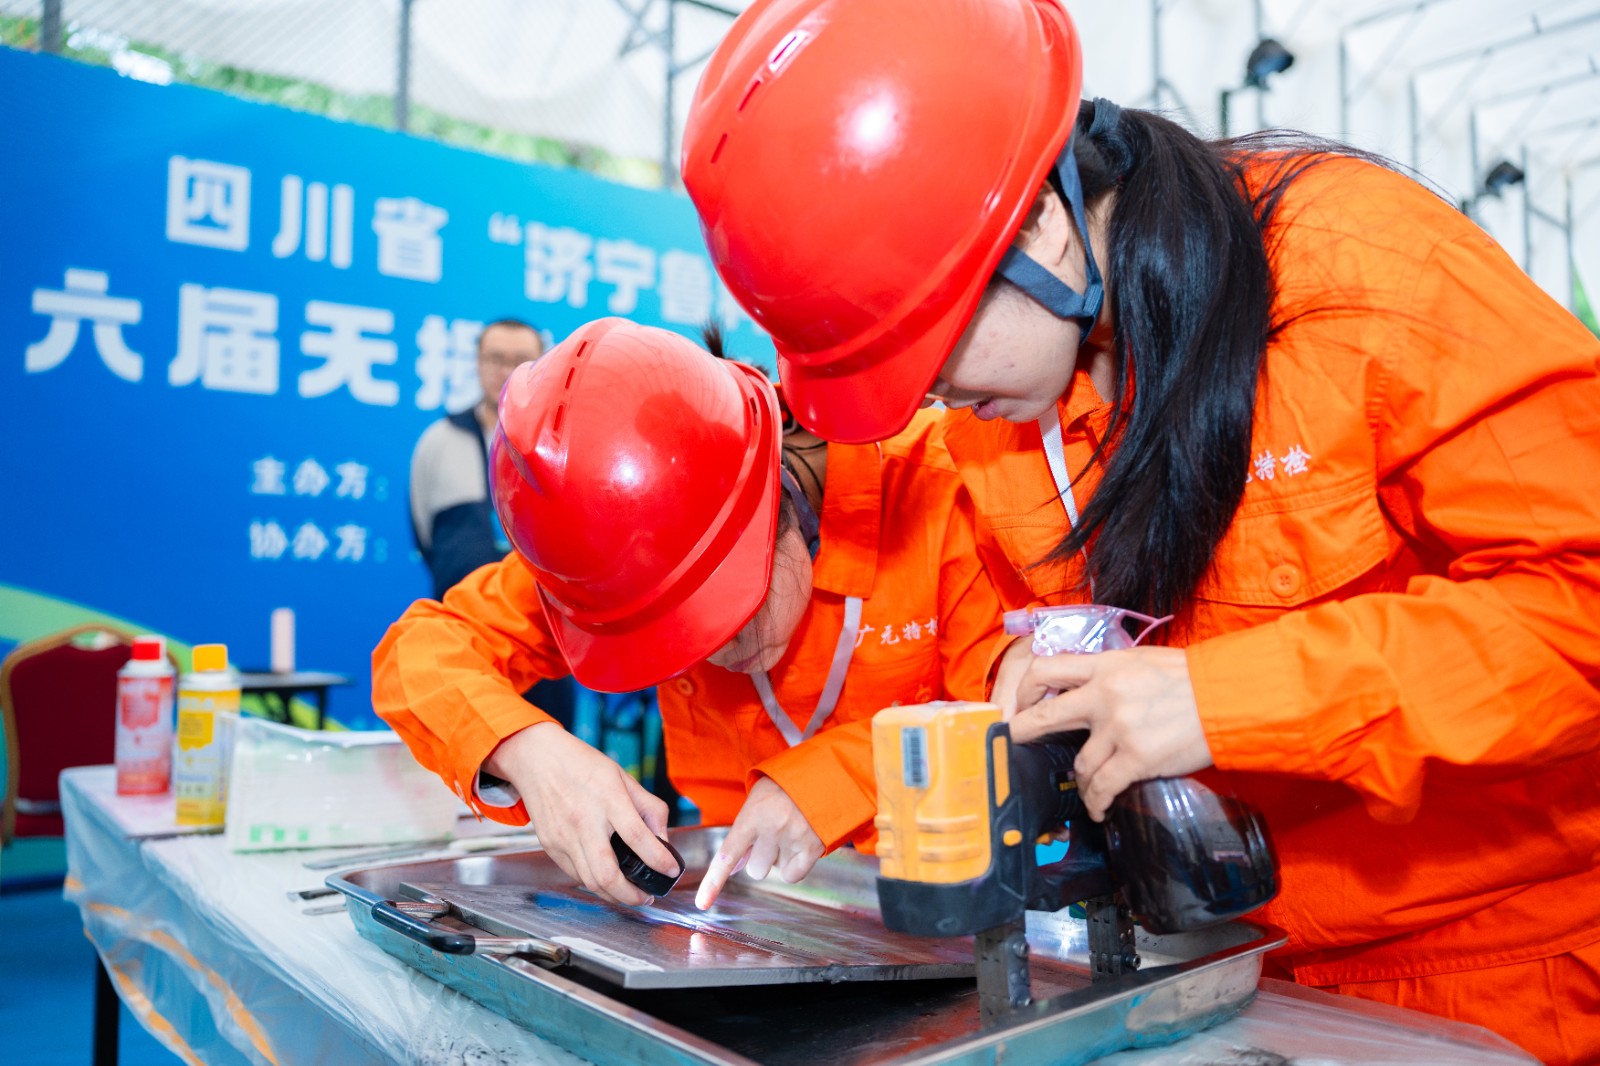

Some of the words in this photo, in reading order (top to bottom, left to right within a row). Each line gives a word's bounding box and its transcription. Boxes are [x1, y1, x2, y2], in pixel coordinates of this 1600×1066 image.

[166, 154, 449, 284] 四川省
[488, 211, 772, 336] “济宁鲁
[24, 267, 555, 416] 六届无损
[1245, 444, 1312, 483] 特检
